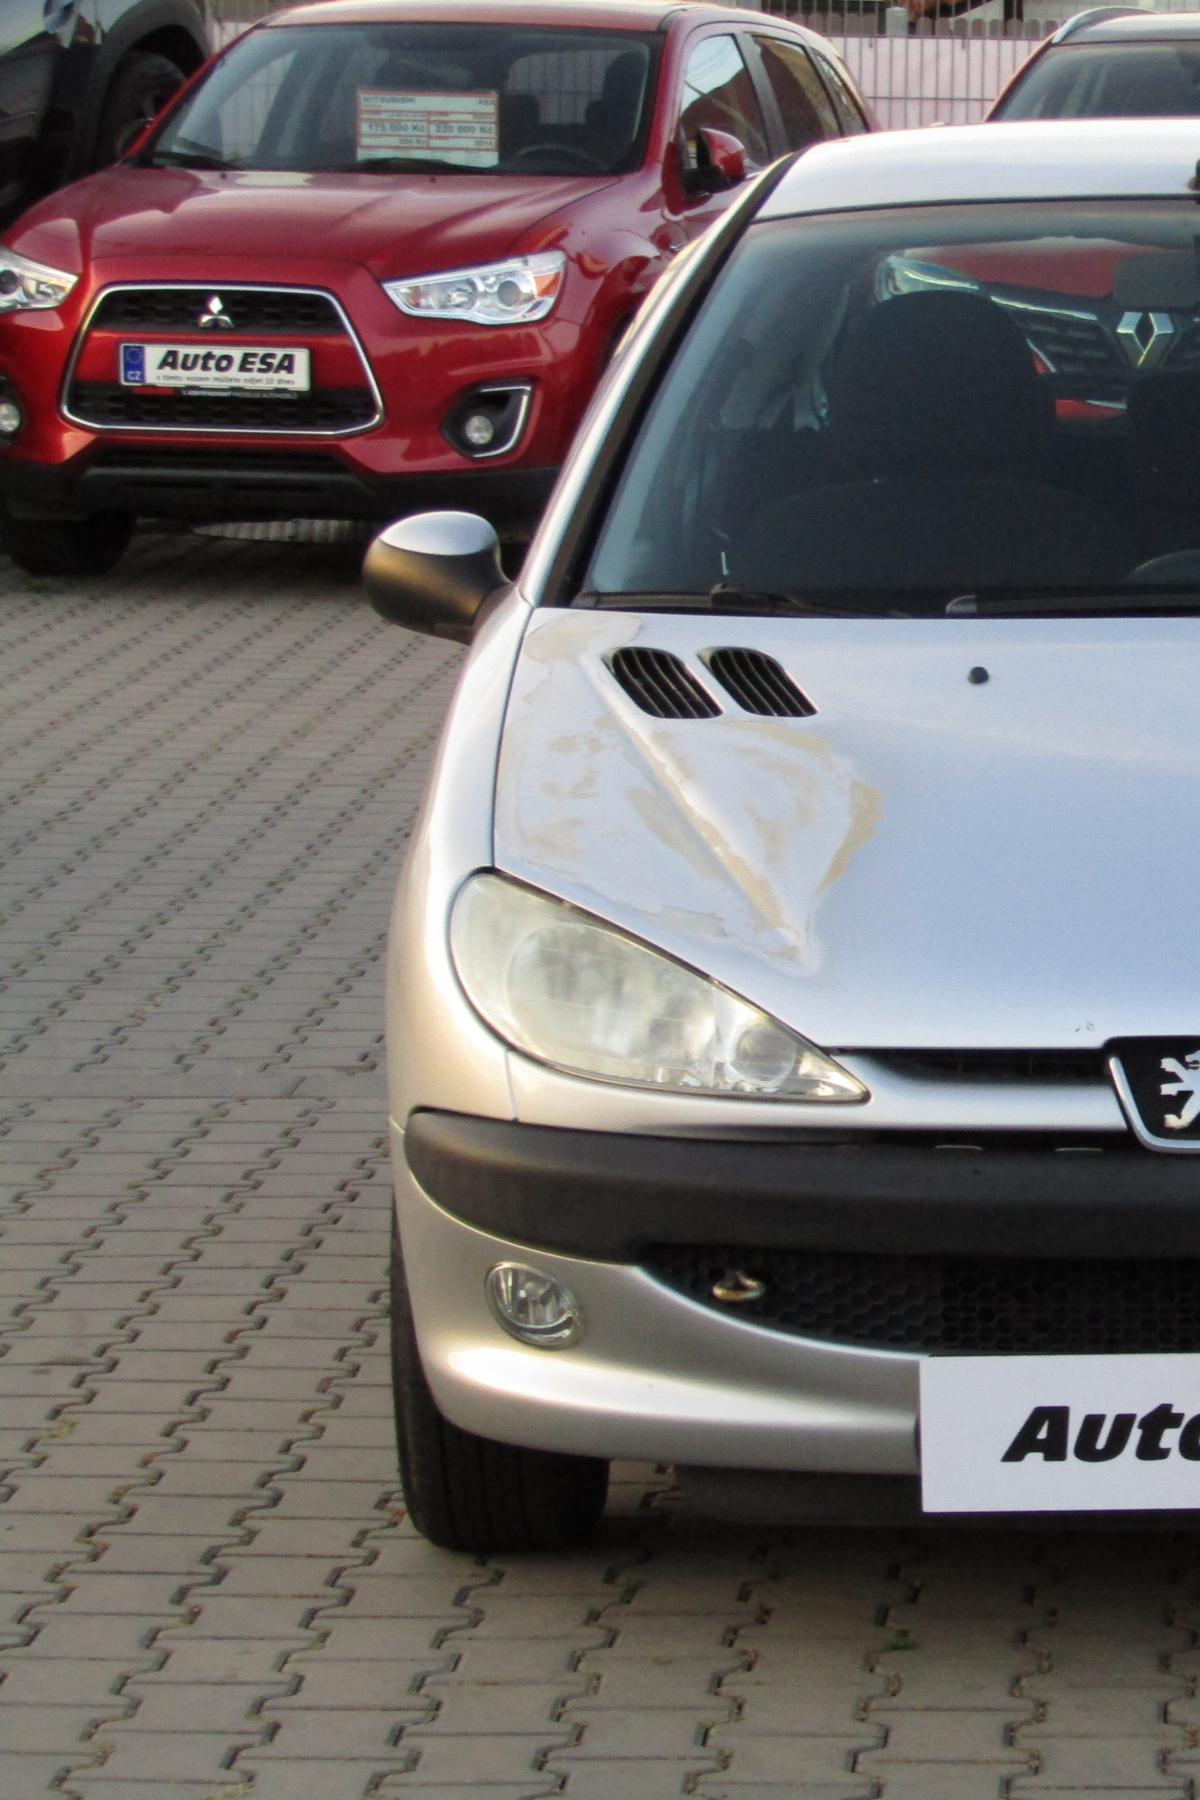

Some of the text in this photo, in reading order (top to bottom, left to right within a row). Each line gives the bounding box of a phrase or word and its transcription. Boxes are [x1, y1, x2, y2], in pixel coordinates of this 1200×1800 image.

[157, 350, 295, 374] Auto ESA
[127, 370, 141, 381] CZ
